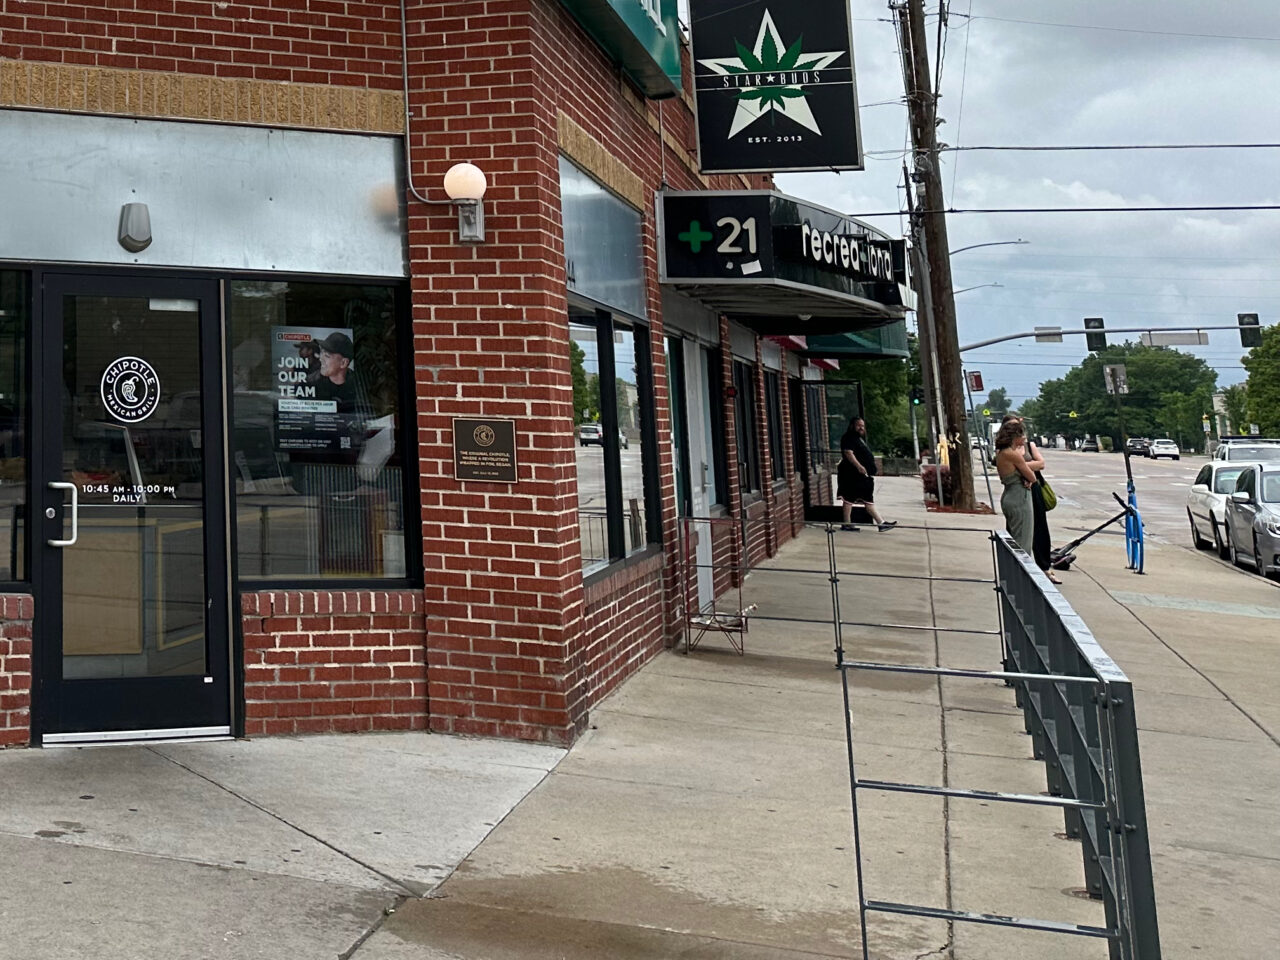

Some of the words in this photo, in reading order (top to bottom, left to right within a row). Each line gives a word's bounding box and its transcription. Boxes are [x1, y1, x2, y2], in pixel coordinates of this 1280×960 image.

[723, 74, 761, 88] STAR
[780, 71, 820, 85] BUDS
[277, 356, 309, 369] JOIN
[106, 361, 156, 386] CHIPOTLE
[278, 371, 308, 383] OUR
[278, 385, 316, 398] TEAM
[107, 394, 137, 417] MEXICAN
[137, 396, 155, 415] GRILL
[82, 484, 109, 493] 10:45
[132, 484, 160, 493] 10:00
[112, 494, 141, 503] DAILY
